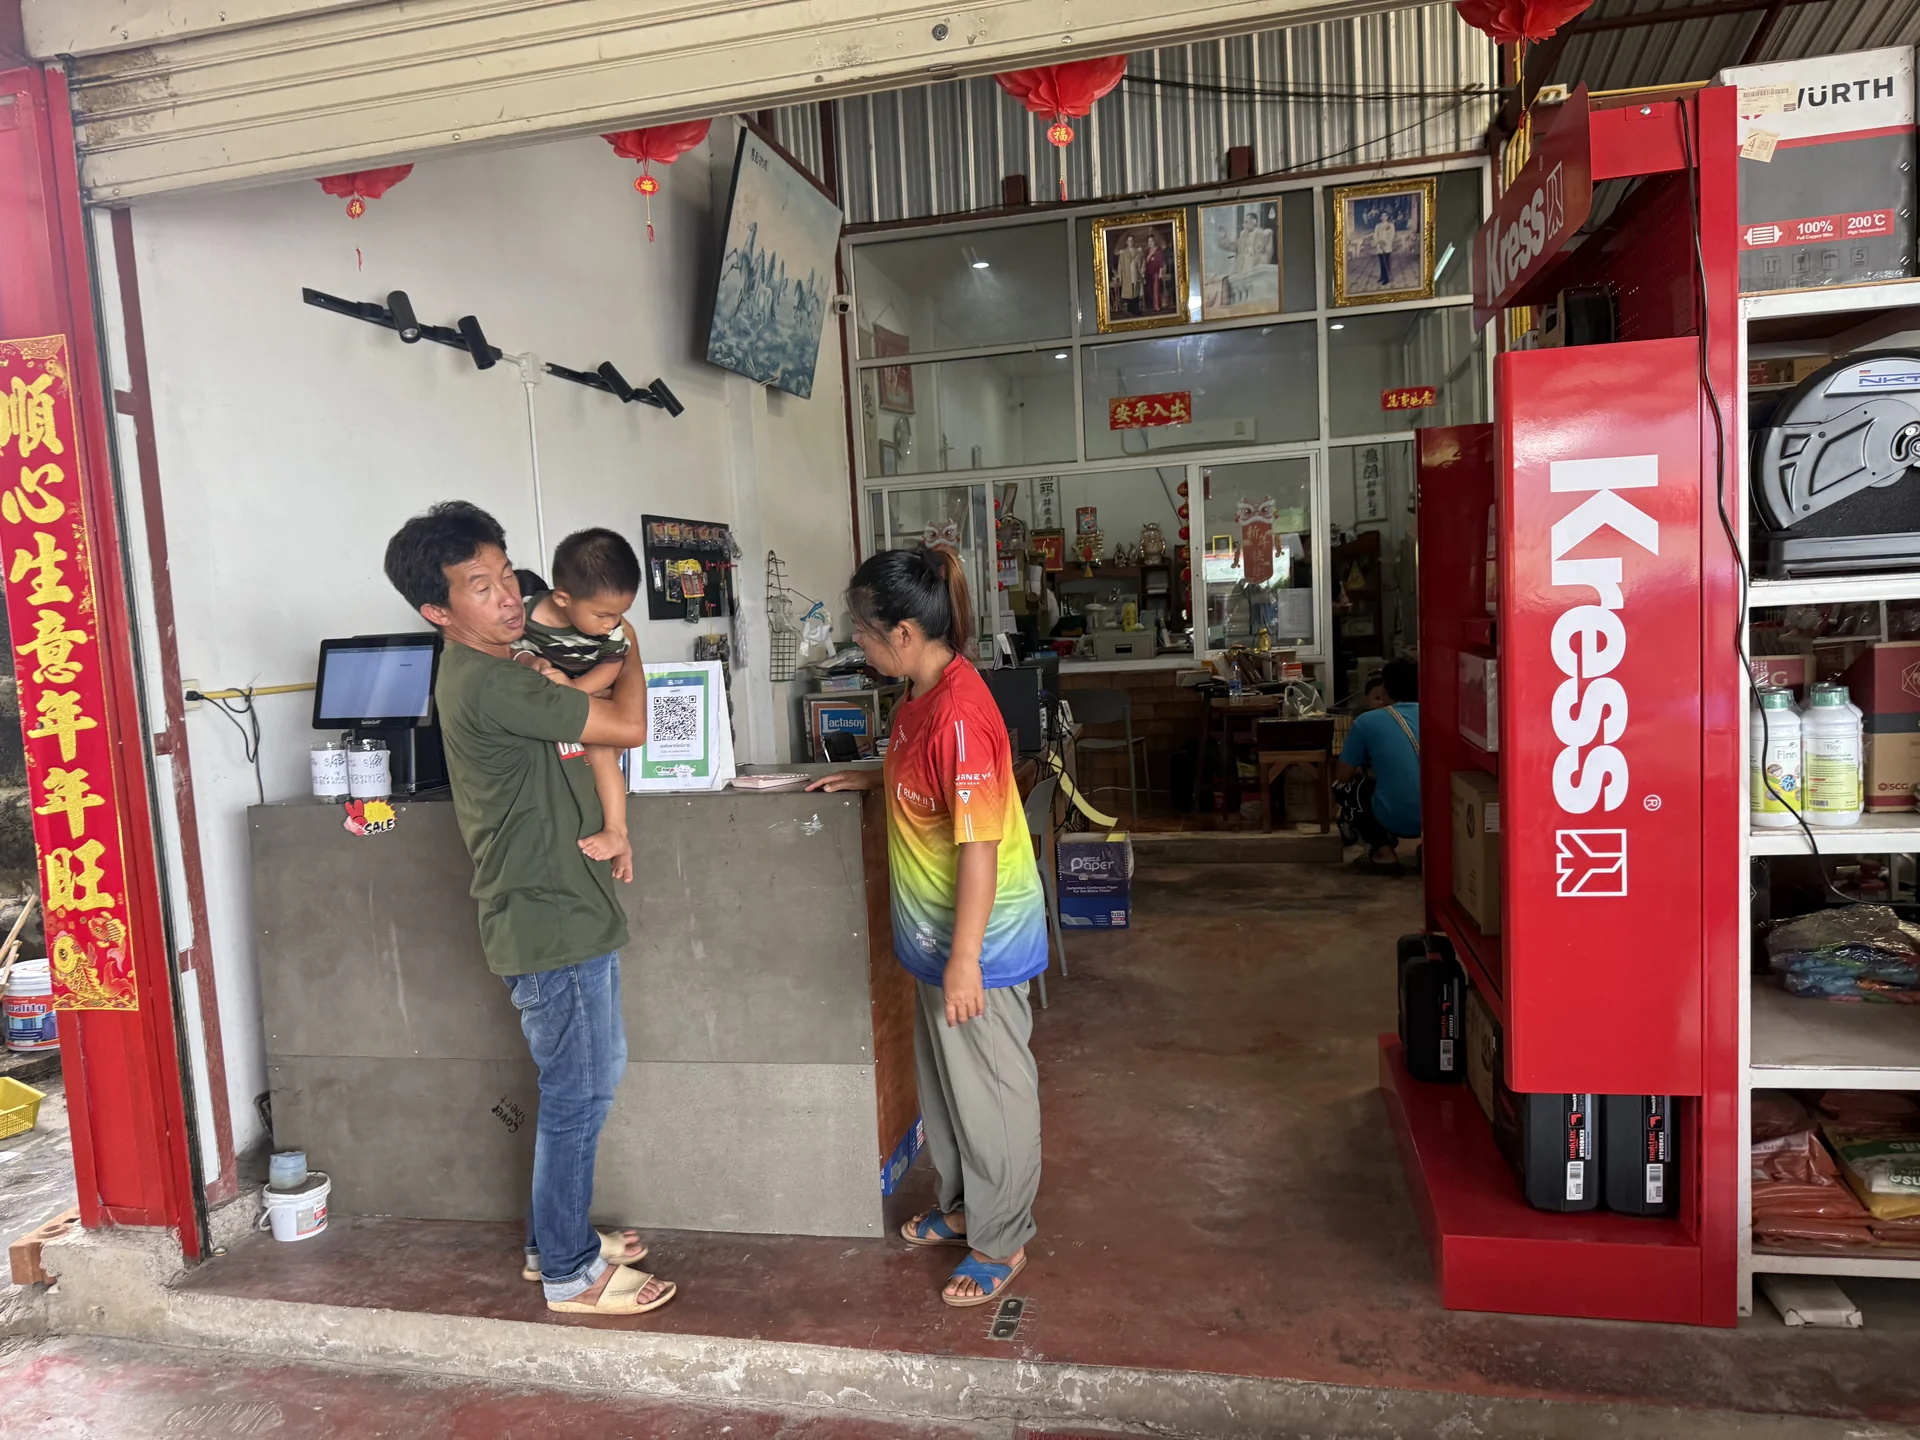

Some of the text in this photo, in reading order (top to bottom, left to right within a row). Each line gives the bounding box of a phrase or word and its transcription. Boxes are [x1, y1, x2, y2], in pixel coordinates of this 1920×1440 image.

[1797, 76, 1894, 109] ÜRTH
[1054, 127, 1068, 141] 福
[1797, 220, 1833, 234] 100%
[1486, 187, 1545, 307] Kress
[0, 374, 116, 911] 順心生意年年旺
[1550, 454, 1659, 814] Kress
[822, 714, 865, 733] Lactasoy
[1776, 751, 1797, 759] Finn
[903, 788, 920, 802] RUN
[364, 818, 395, 834] SALE
[1070, 857, 1115, 872] Paper
[1569, 1129, 1577, 1159] maktec
